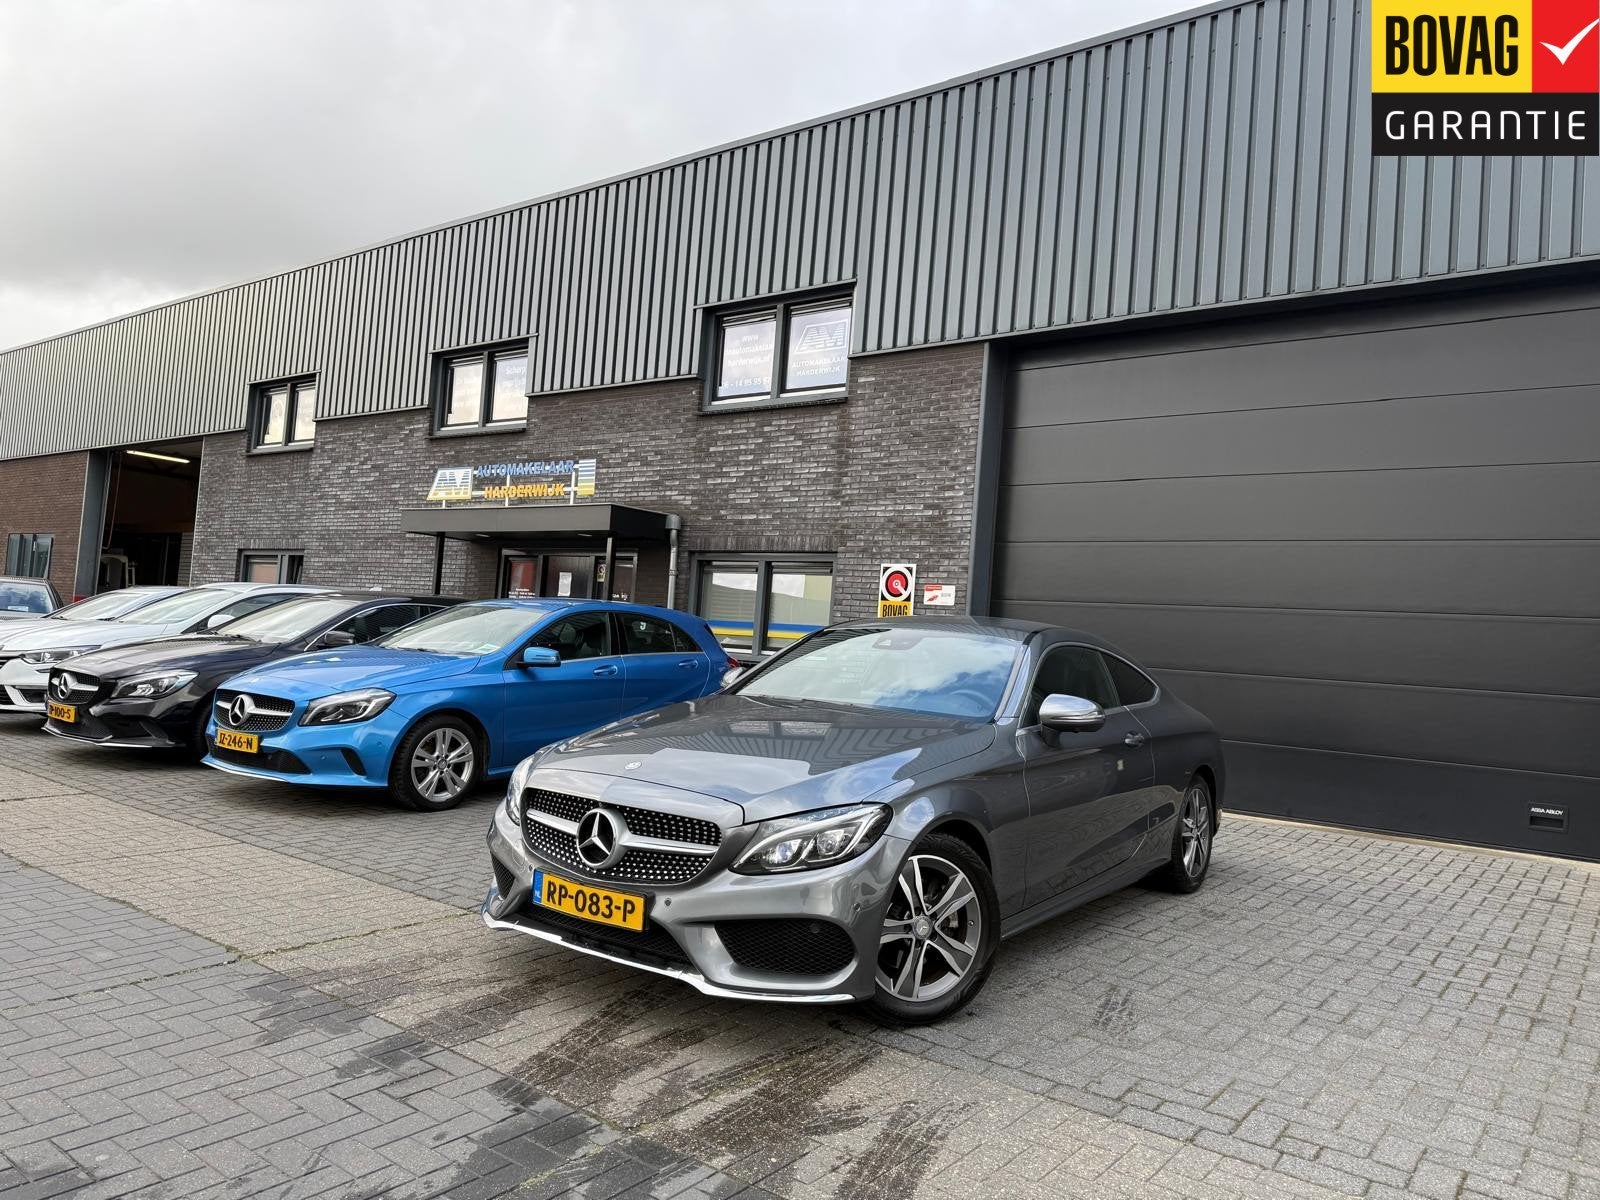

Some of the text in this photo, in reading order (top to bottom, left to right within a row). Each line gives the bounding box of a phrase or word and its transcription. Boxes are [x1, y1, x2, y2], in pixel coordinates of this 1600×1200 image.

[475, 460, 575, 478] AUTOMAKELAAR
[484, 483, 565, 499] HARDERWIJK
[882, 604, 908, 618] BOVAG
[546, 880, 636, 922] RP-083-P
